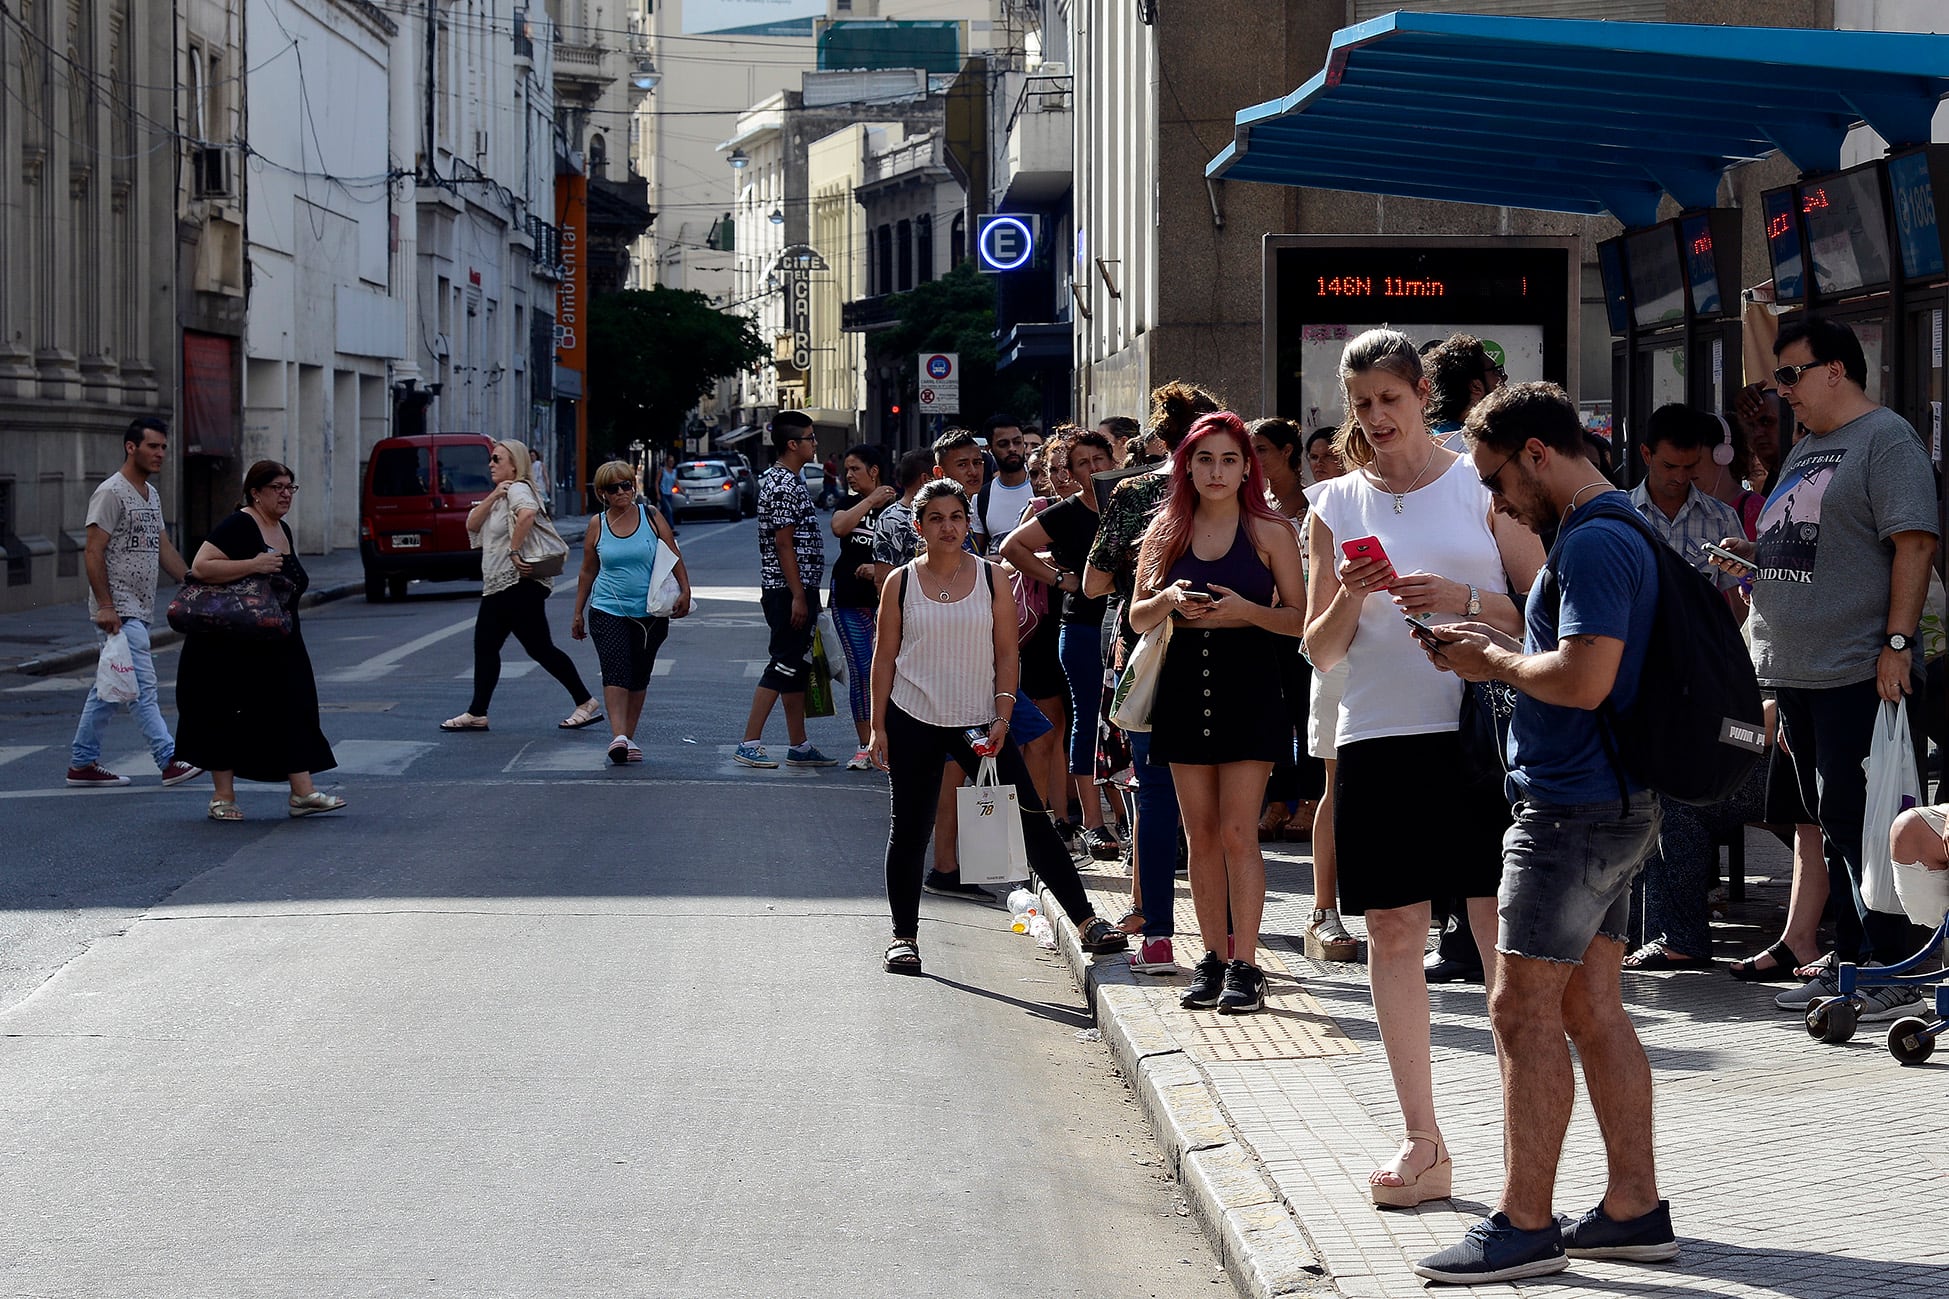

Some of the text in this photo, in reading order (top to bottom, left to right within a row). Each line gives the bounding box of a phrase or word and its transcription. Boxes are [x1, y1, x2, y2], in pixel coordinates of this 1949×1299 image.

[1910, 184, 1936, 228] 1805
[994, 228, 1017, 257] E
[782, 256, 821, 270] CINE
[794, 270, 808, 280] EL
[1317, 276, 1444, 296] 146N 11min
[795, 281, 809, 367] CAIRO
[1729, 726, 1754, 743] PUMA
[979, 804, 995, 817] 78
